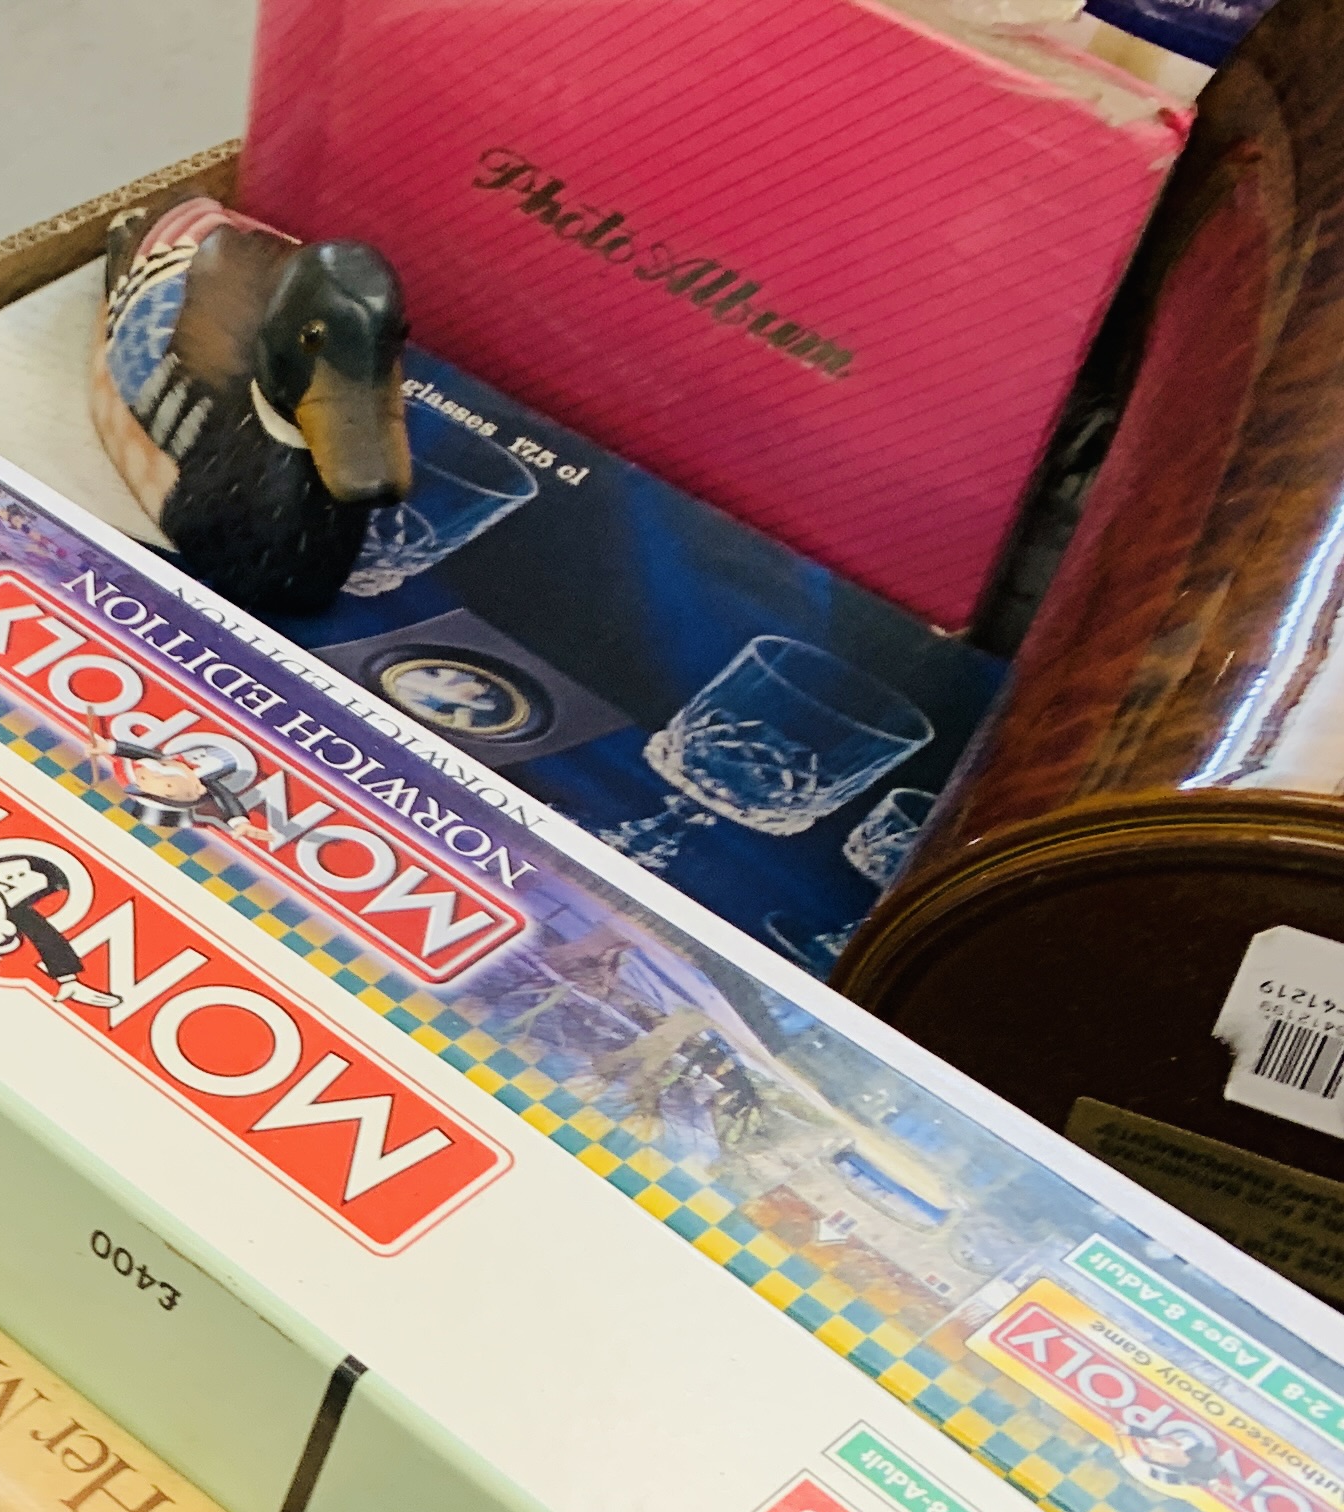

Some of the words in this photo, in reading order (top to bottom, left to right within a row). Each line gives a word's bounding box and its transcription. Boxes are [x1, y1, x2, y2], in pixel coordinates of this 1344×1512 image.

[471, 147, 636, 264] Photo
[633, 241, 856, 380] Album
[61, 567, 291, 735] EDITION
[277, 712, 539, 890] NORWICH
[90, 1229, 183, 1311] £400
[1088, 1251, 1187, 1321] 8-Adult
[1090, 1319, 1152, 1367] Game
[1190, 1318, 1260, 1367] Ages
[1156, 1364, 1226, 1418] Opoly
[1281, 1382, 1334, 1419] 2-8
